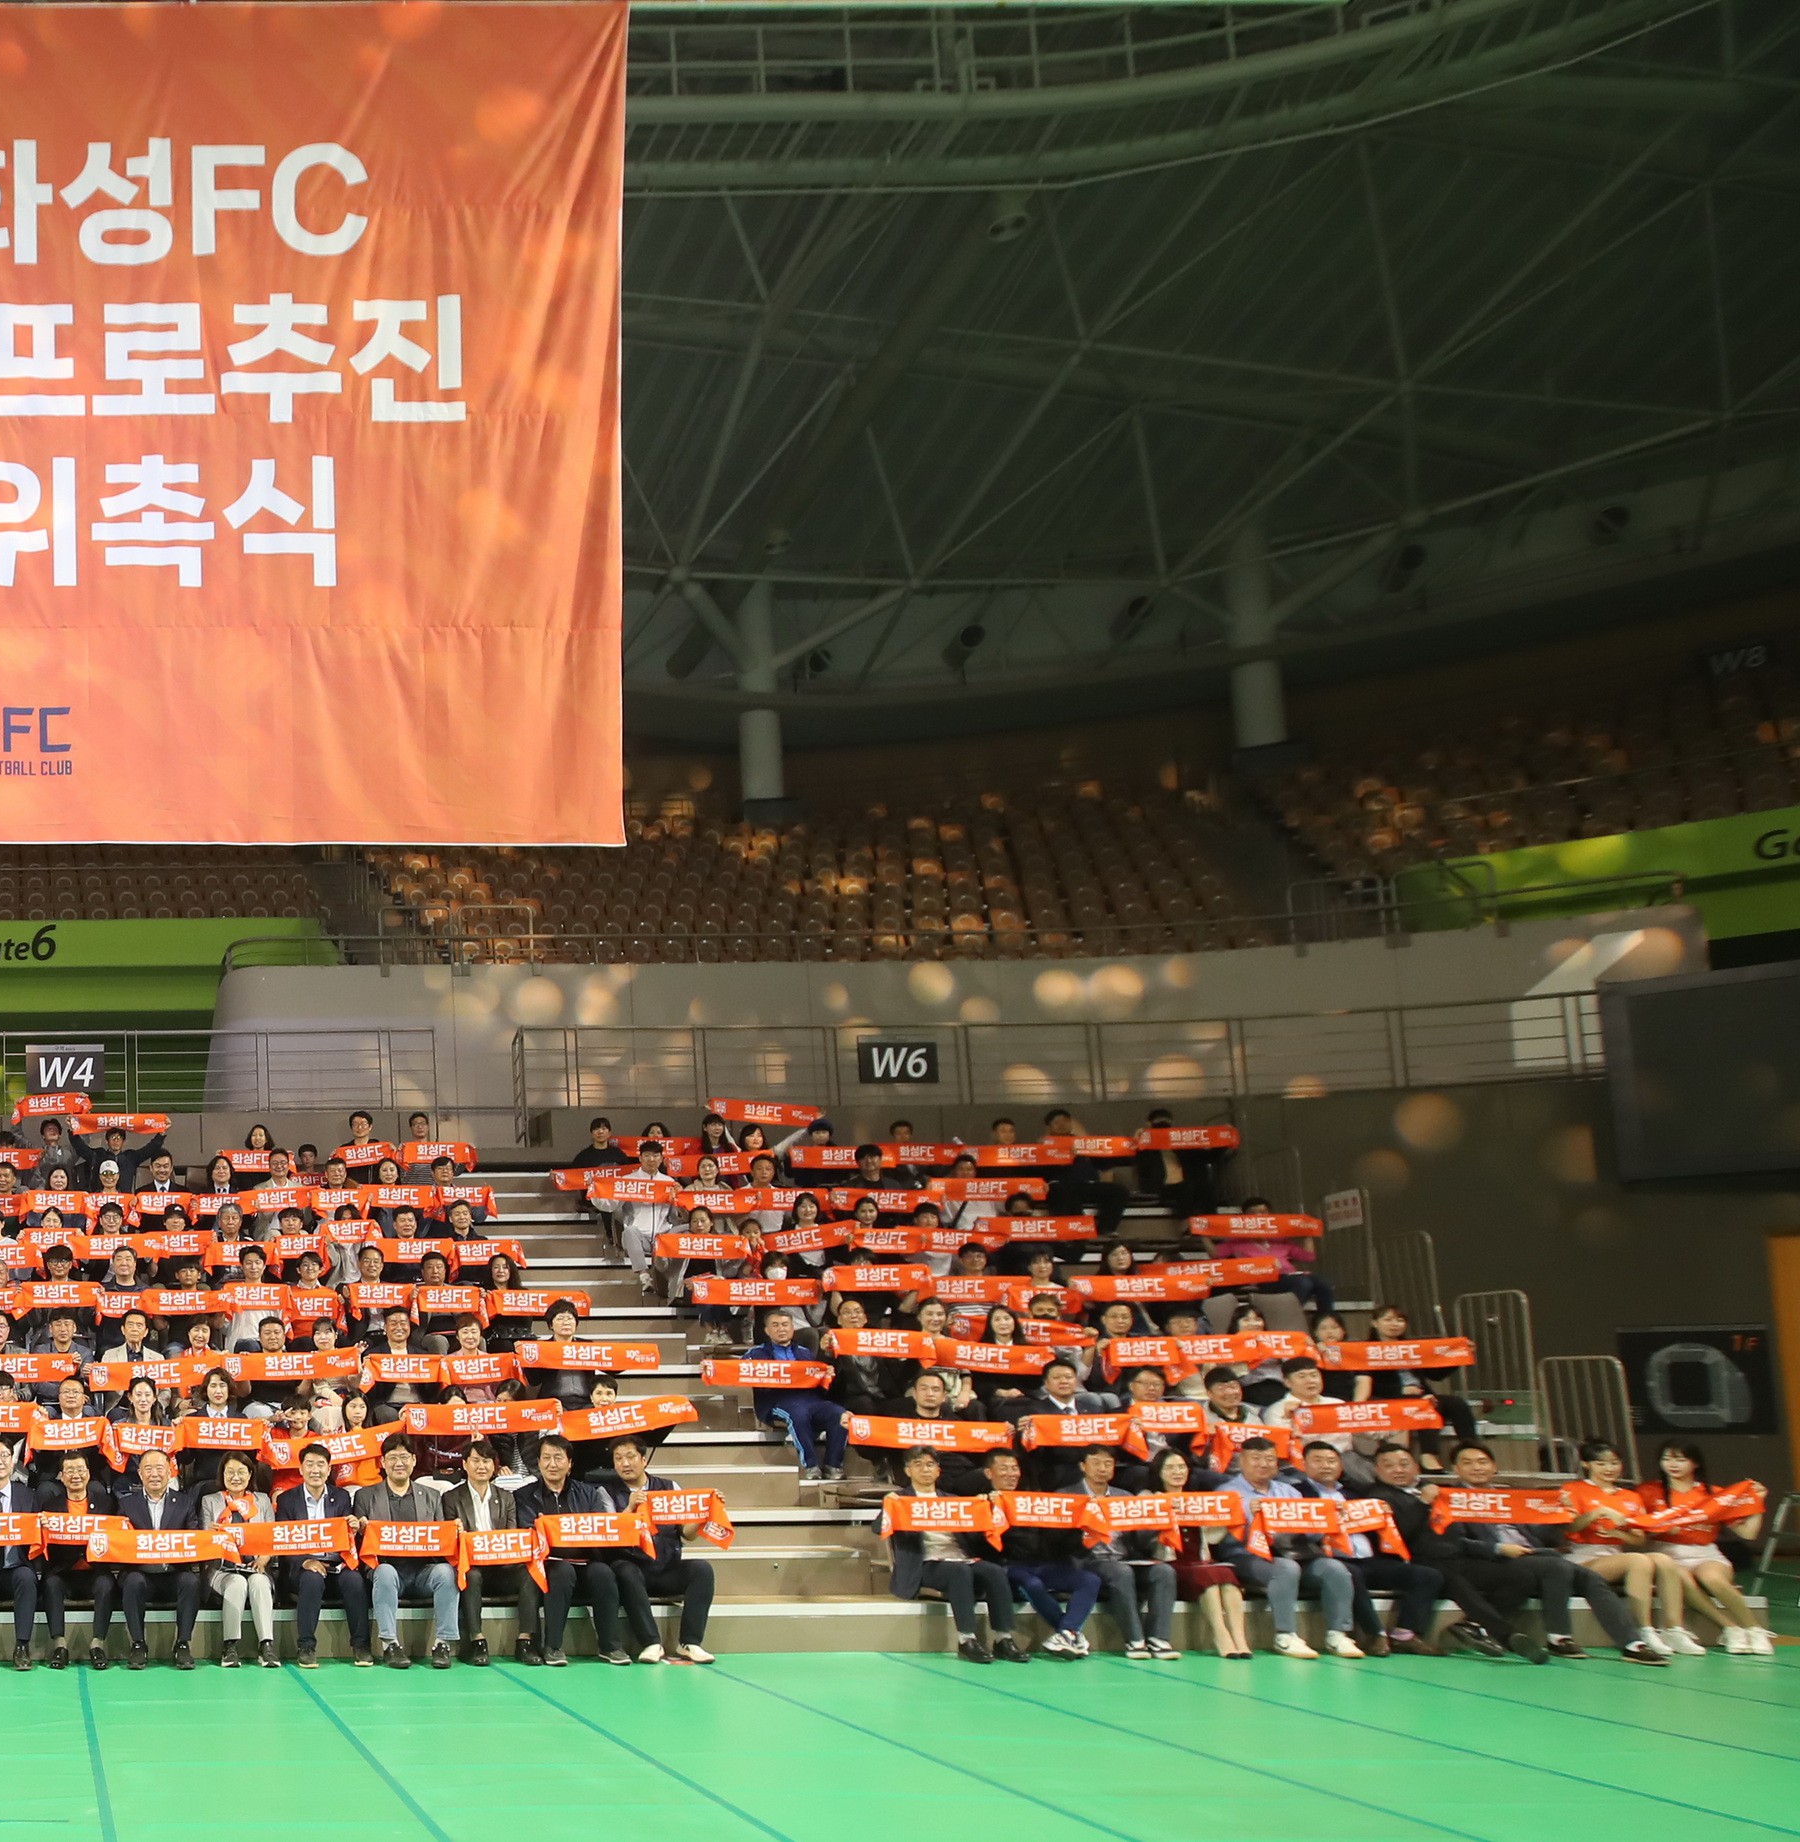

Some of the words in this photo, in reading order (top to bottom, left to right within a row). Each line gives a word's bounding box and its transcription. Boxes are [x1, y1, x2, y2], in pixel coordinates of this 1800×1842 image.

[41, 760, 72, 775] CLUB
[872, 1047, 928, 1078] W6
[39, 1057, 94, 1087] W4
[28, 1096, 65, 1108] 화성FC
[745, 1104, 782, 1118] 화성FC
[97, 1116, 134, 1128] 화성FC
[345, 1146, 383, 1159] 화성FC
[417, 1145, 454, 1156] 화성FC
[232, 1152, 270, 1164] 화성FC
[378, 1188, 418, 1200] 화성FC
[614, 1181, 655, 1194] 화성FC
[966, 1182, 1008, 1195] 화성FC
[35, 1193, 75, 1206] 화성FC
[258, 1190, 296, 1204] 화성FC
[318, 1191, 358, 1203] 화성FC
[694, 1194, 734, 1205] 화성FC
[1010, 1219, 1056, 1233] 화성FC
[30, 1232, 69, 1244] 화성FC
[280, 1236, 321, 1249] 화성FC
[678, 1238, 722, 1250] 화성FC
[776, 1229, 822, 1247] 화성FC
[863, 1232, 905, 1245] 화성FC
[398, 1242, 440, 1254] 화성FC
[856, 1268, 899, 1281] 화성FC
[33, 1285, 78, 1298] 화성FC
[358, 1285, 403, 1298] 화성FC
[730, 1283, 775, 1296] 화성FC
[937, 1280, 985, 1293] 화성FC
[1115, 1278, 1165, 1292] 화성FC
[159, 1292, 205, 1305] 화성FC
[235, 1286, 279, 1299] 화성FC
[427, 1289, 471, 1302] 화성FC
[503, 1293, 548, 1306] 화성FC
[858, 1332, 908, 1348] 화성FC
[562, 1345, 612, 1360] 화성FC
[956, 1345, 1010, 1362] 화성FC
[1117, 1342, 1170, 1356] 화성FC
[1367, 1345, 1420, 1359] 화성FC
[265, 1355, 313, 1369] 화성FC
[381, 1358, 430, 1372] 화성FC
[453, 1358, 500, 1372] 화성FC
[739, 1363, 791, 1377] 화성FC
[454, 1407, 507, 1423] 화성FC
[588, 1402, 645, 1425] 화성FC
[1140, 1406, 1195, 1422] 화성FC
[1337, 1404, 1390, 1419] 화성FC
[44, 1421, 95, 1437] 화성FC
[198, 1422, 251, 1438] 화성FC
[897, 1423, 955, 1439] 화성FC
[1061, 1418, 1117, 1433] 화성FC
[122, 1431, 173, 1447] 화성FC
[652, 1494, 710, 1513] 화성FC
[911, 1502, 972, 1519] 화성FC
[1016, 1497, 1074, 1515] 화성FC
[1110, 1499, 1168, 1518] 화성FC
[1262, 1503, 1327, 1521] 화성FC
[560, 1516, 617, 1535] 화성FC
[273, 1524, 332, 1542] 화성FC
[380, 1526, 440, 1543] 화성FC
[136, 1534, 196, 1551] 화성FC
[473, 1534, 532, 1552] 화성FC
